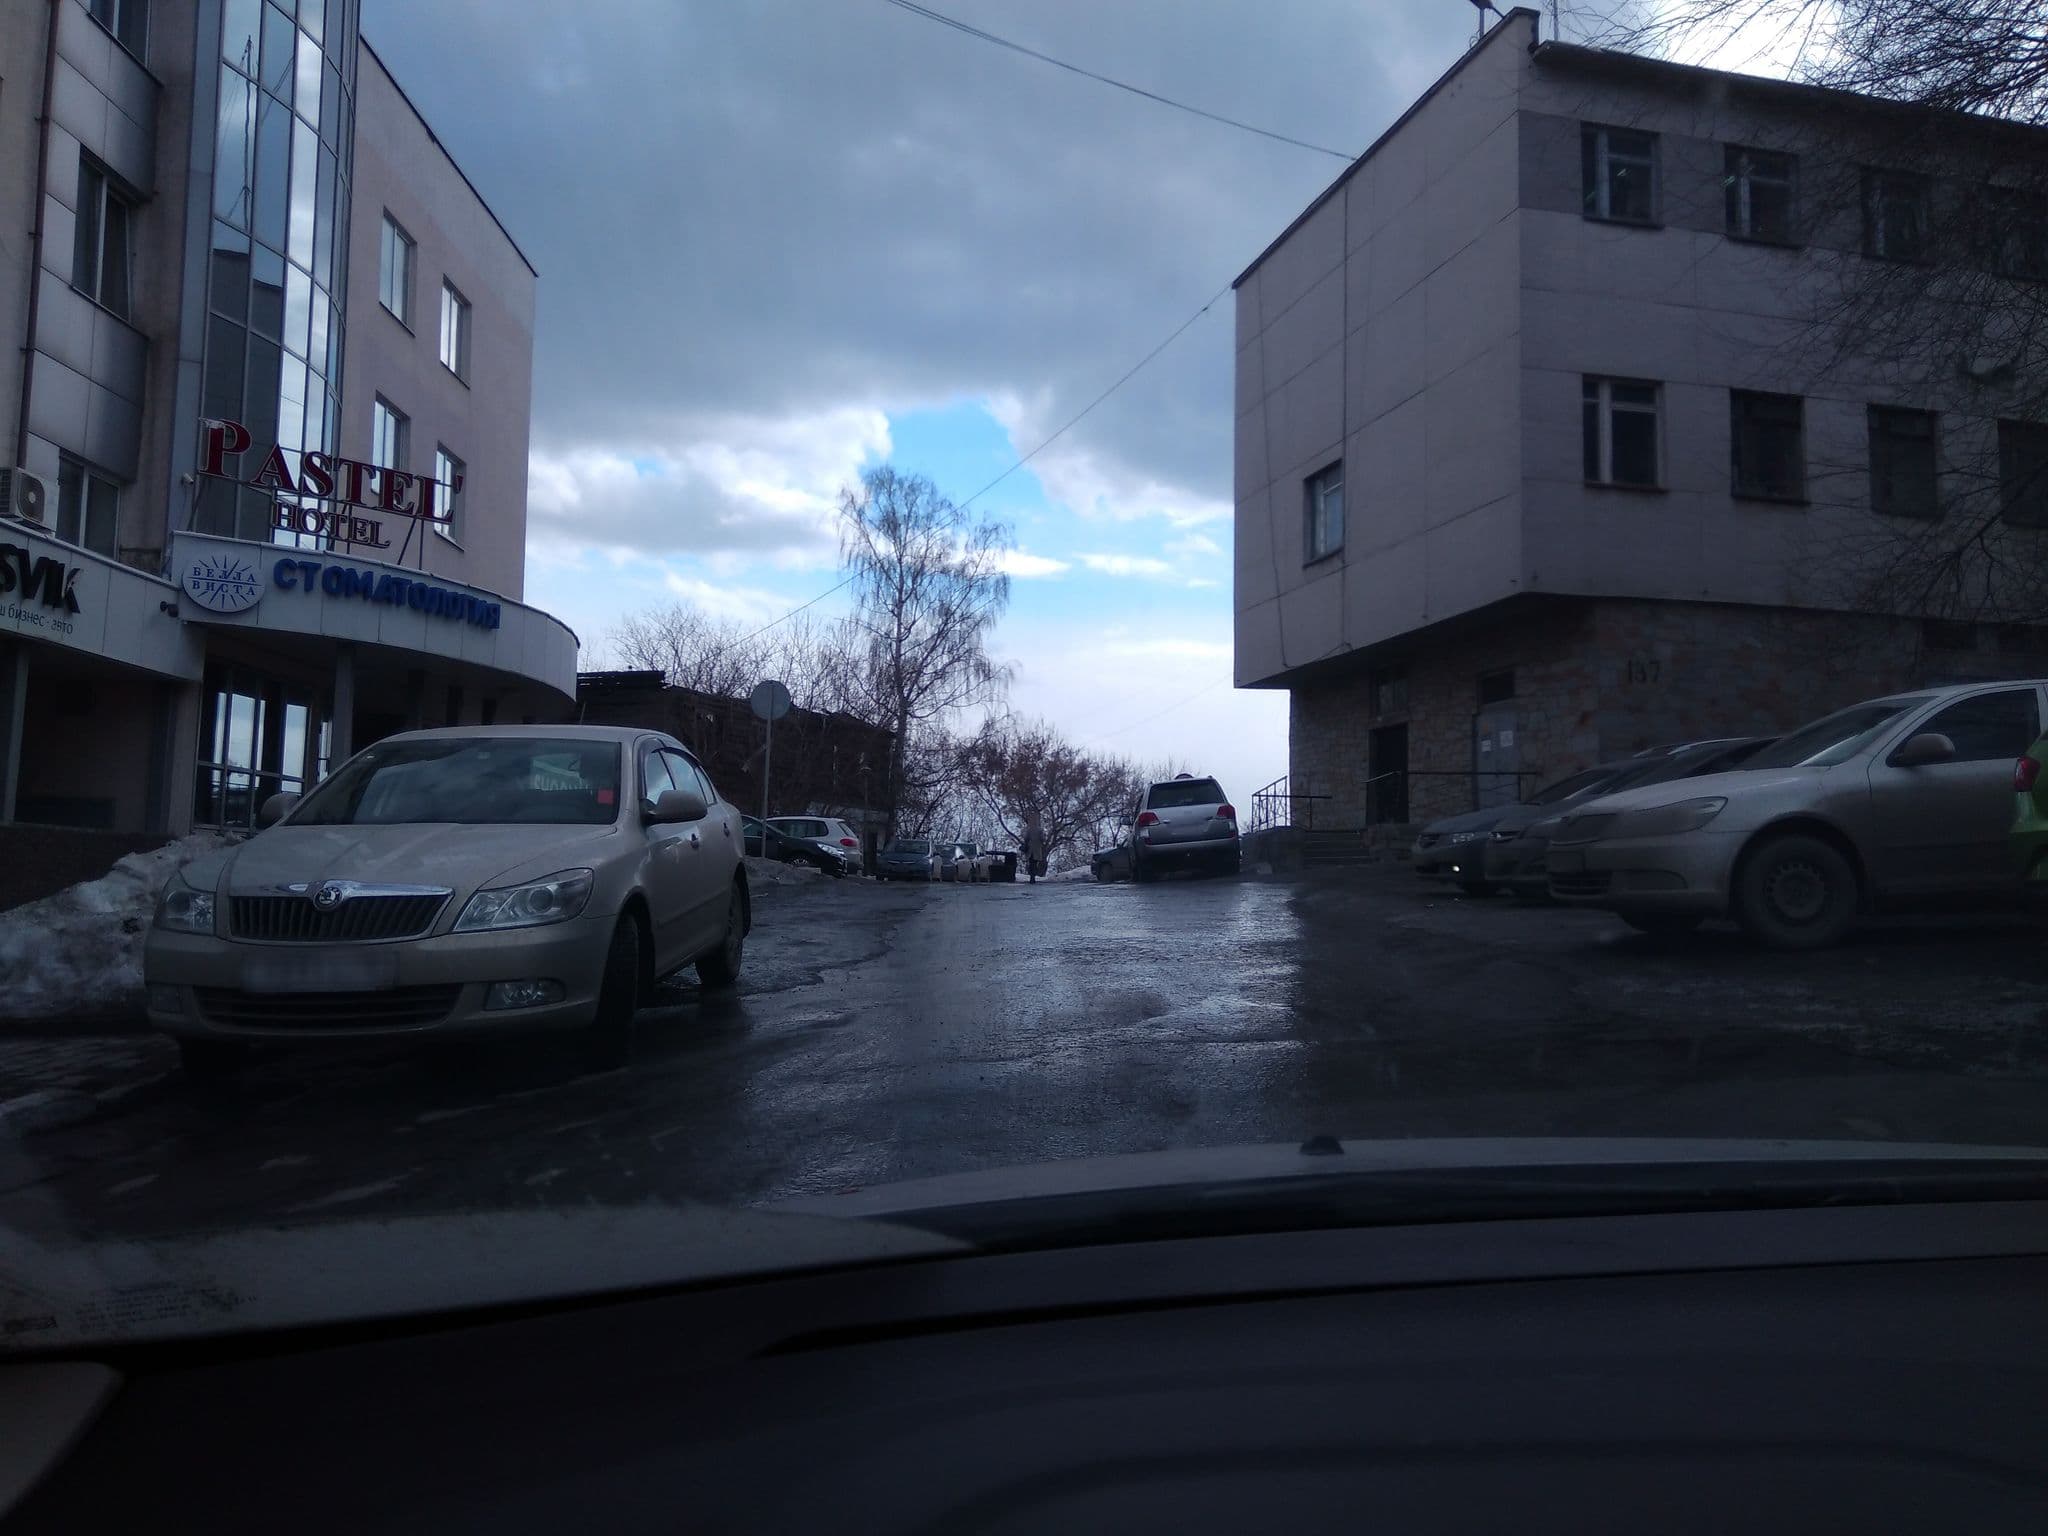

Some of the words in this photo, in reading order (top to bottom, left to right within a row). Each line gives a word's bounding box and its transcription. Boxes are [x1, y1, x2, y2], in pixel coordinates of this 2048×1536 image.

[272, 501, 392, 549] HOTEL
[191, 579, 256, 597] ВИСТА
[192, 565, 257, 584] БЕЛЛА
[272, 557, 501, 630] СТОМАТОЛОГИЯ
